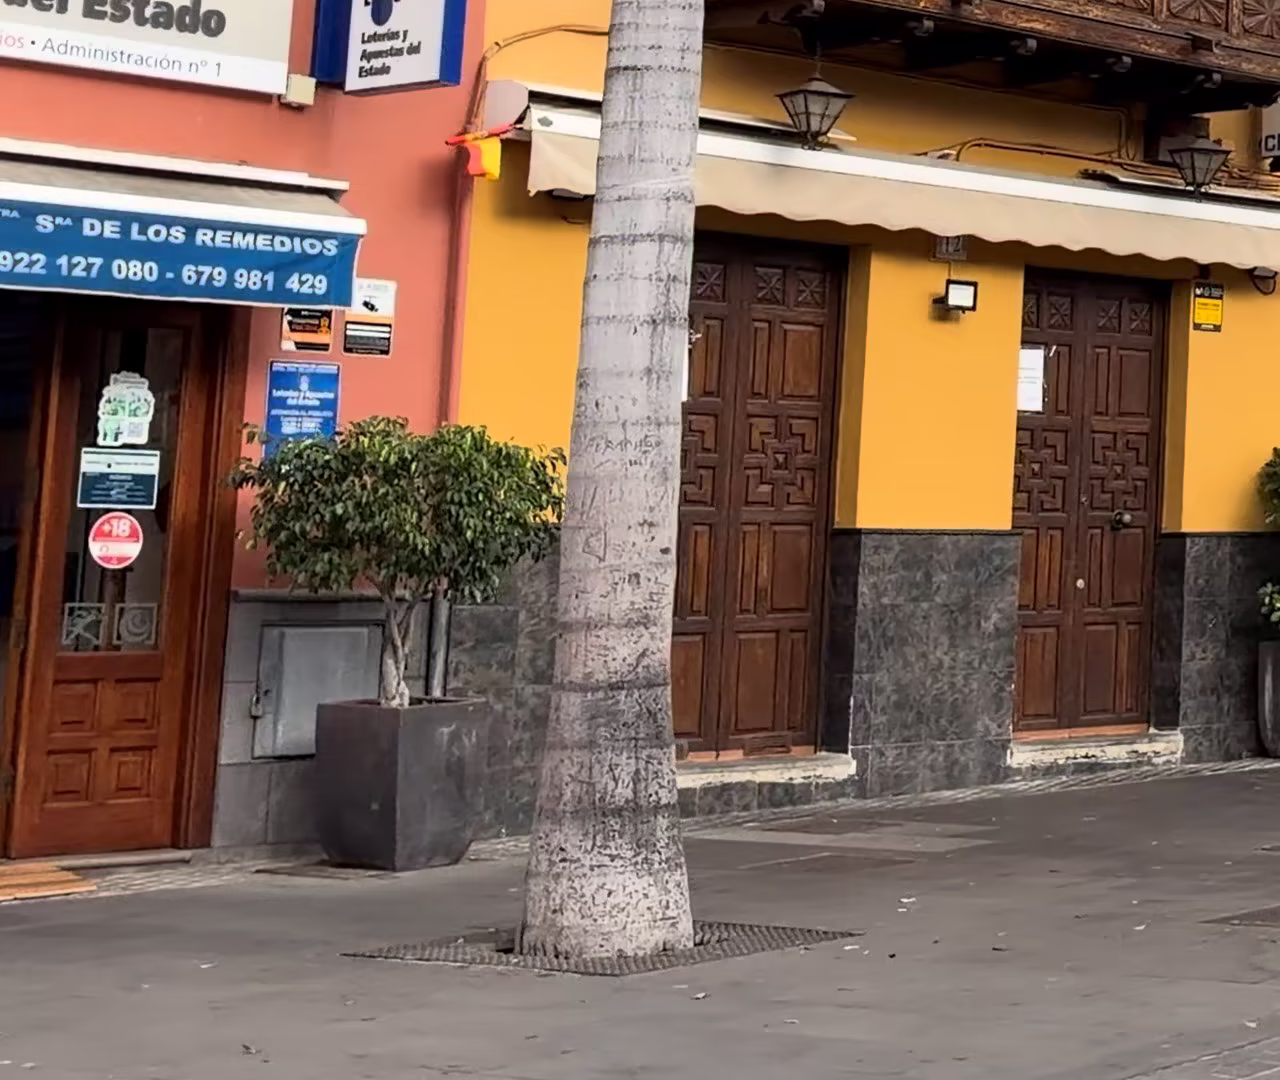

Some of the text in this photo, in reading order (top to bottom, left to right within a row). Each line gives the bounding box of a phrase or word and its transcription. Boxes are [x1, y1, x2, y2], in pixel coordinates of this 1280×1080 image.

[361, 28, 409, 44] Loterías y
[42, 37, 182, 72] Administración
[215, 62, 222, 77] 1
[360, 41, 422, 64] Apuestas del
[358, 63, 391, 78] Estado
[82, 218, 121, 239] DE
[131, 222, 186, 244] LOS
[195, 228, 339, 257] REMEDIOS
[0, 250, 47, 275] 922
[56, 255, 103, 278] 127
[112, 259, 159, 282] 080
[181, 264, 227, 287] 679
[233, 267, 274, 291] 981
[284, 271, 328, 295] 429
[102, 518, 131, 538] +18
